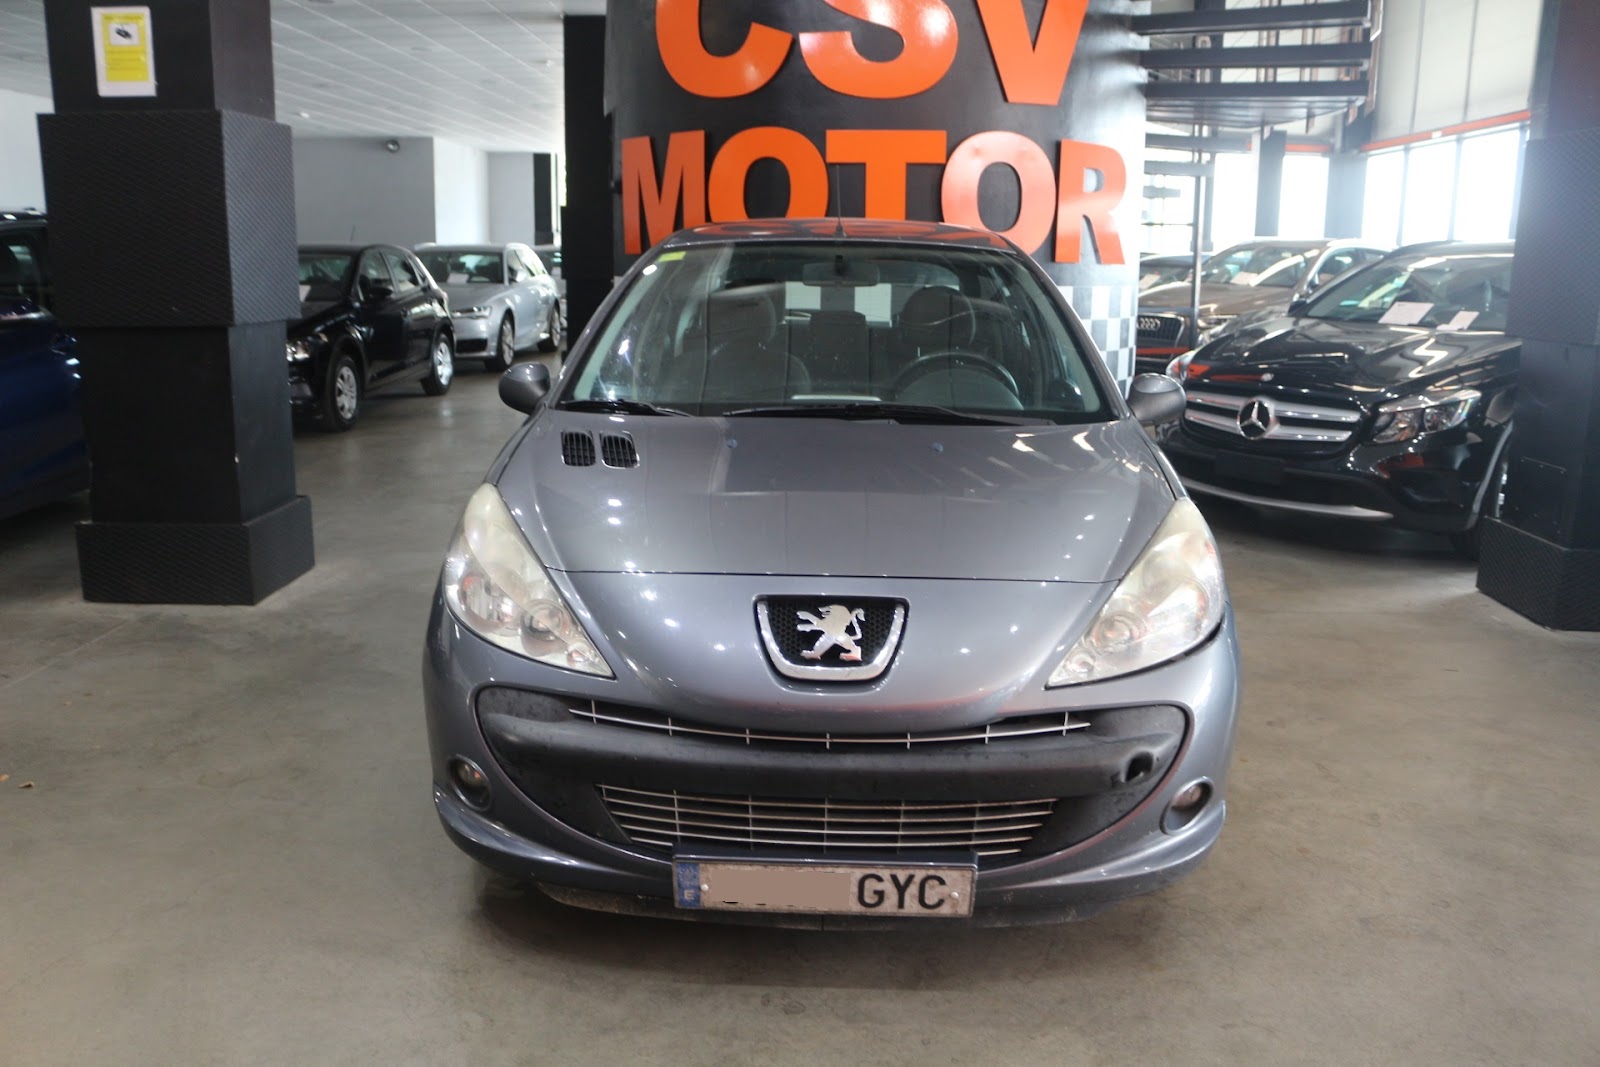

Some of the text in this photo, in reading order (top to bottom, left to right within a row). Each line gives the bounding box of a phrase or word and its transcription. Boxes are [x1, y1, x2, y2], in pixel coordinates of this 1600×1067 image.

[656, 0, 1089, 106] CSV
[621, 126, 1127, 265] MOTOR
[857, 873, 946, 910] GYC
